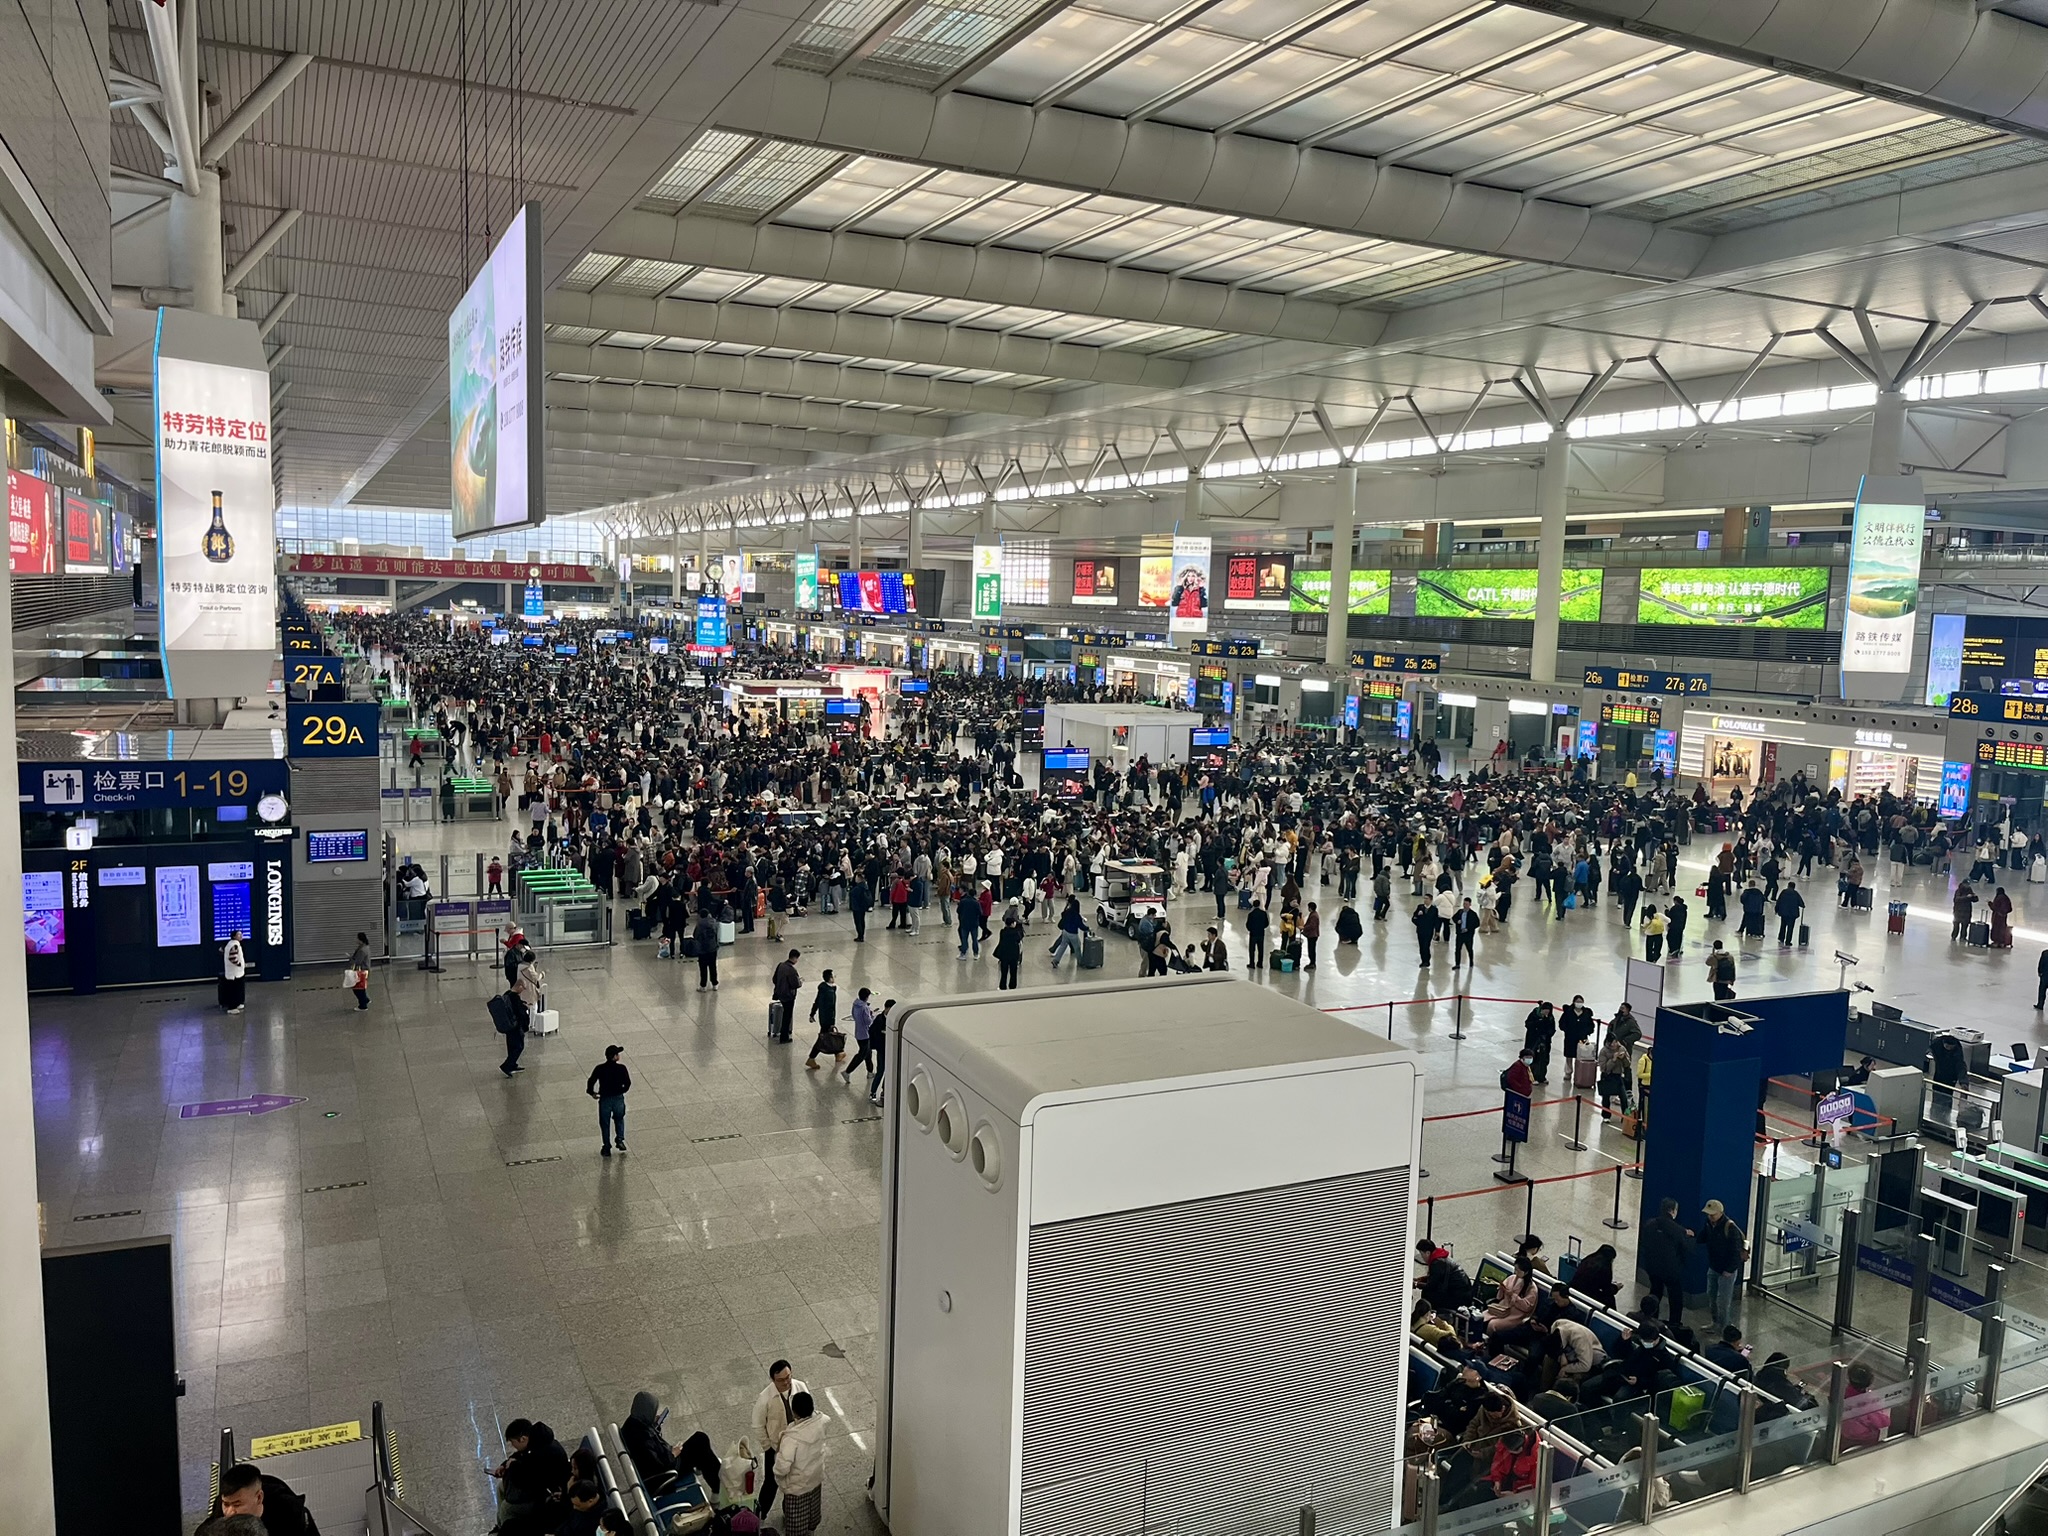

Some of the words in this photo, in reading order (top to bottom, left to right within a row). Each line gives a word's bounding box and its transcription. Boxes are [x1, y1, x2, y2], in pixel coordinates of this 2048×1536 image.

[163, 411, 268, 442] 特劳特定位
[164, 438, 267, 459] 助力青花郎脱颖而出
[170, 582, 268, 595] 特劳特战略定位咨询
[1467, 587, 1499, 601] CATL
[1728, 582, 1800, 597] 认准宁德时代
[294, 665, 336, 684] 27A
[1585, 671, 1603, 684] 26B
[1665, 677, 1685, 691] 27B
[1690, 678, 1708, 692] 27B
[1951, 697, 1979, 714] 28B
[2024, 702, 2048, 714] 检票
[302, 715, 365, 745] 29A
[93, 770, 165, 791] 检票口
[173, 769, 249, 798] 1-19
[93, 793, 136, 802] Check-in
[71, 860, 88, 871] 2F
[267, 860, 284, 946] LONGINES
